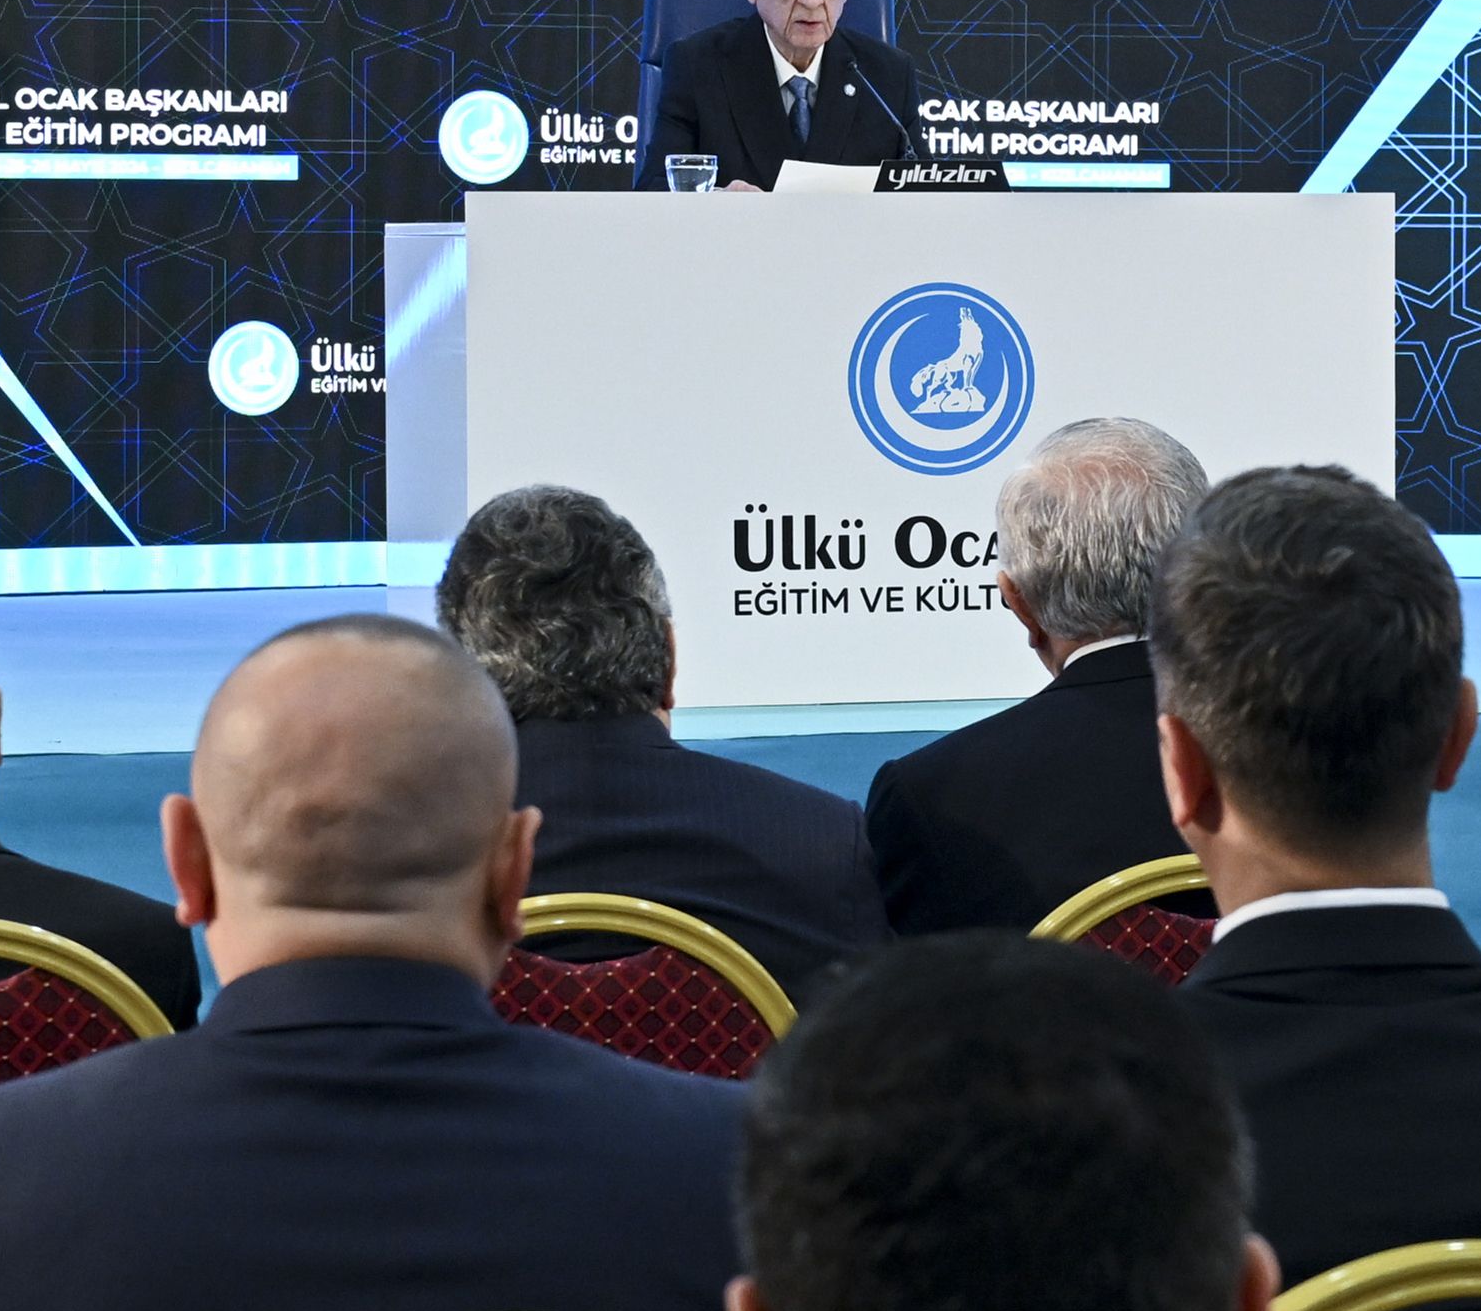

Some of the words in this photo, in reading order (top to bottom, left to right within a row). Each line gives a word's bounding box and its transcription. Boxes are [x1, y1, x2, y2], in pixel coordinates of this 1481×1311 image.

[14, 87, 98, 111] OCAK
[105, 88, 288, 117] BAŞKANLARI
[918, 99, 981, 122] CAK
[986, 100, 1159, 128] BAŞKANLARI
[5, 116, 102, 145] EĞİTİM
[110, 123, 266, 147] PROGRAMI
[540, 108, 604, 143] Ülkü
[540, 145, 596, 164] EĞİTİM
[599, 148, 622, 164] VE
[922, 126, 984, 154] İTİM
[991, 133, 1138, 156] PROGRAMI
[311, 337, 375, 372] Ülkü
[311, 375, 368, 394] EĞİTİM
[732, 502, 867, 573] Ülkü
[733, 580, 850, 617] EĞİTİM
[860, 585, 904, 614] VE
[915, 577, 1015, 613] KÜLT
